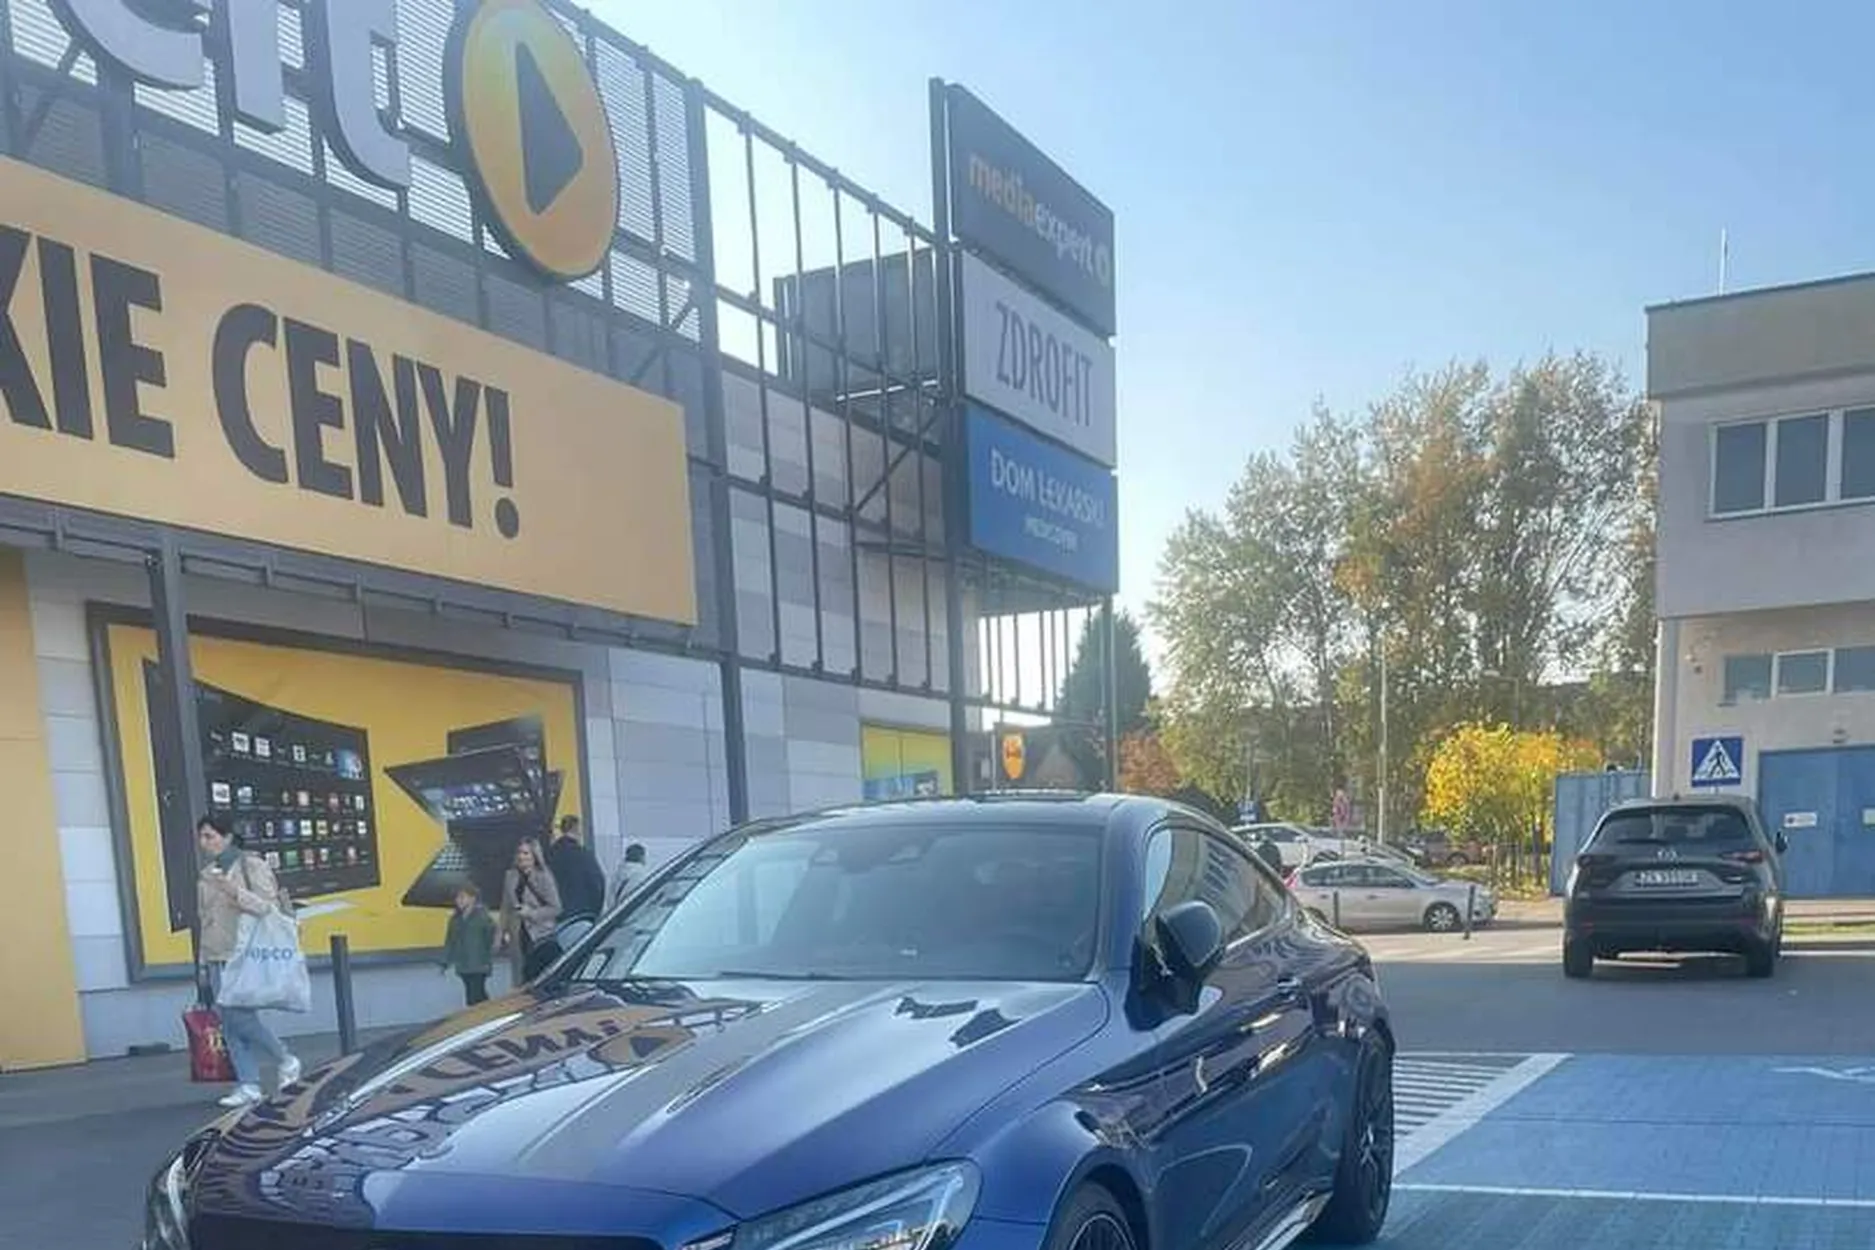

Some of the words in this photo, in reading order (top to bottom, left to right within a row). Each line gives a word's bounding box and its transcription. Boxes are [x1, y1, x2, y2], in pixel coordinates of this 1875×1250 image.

[212, 302, 520, 540] CENY!
[995, 299, 1093, 428] ZDROFIT
[990, 448, 1035, 501] DOM
